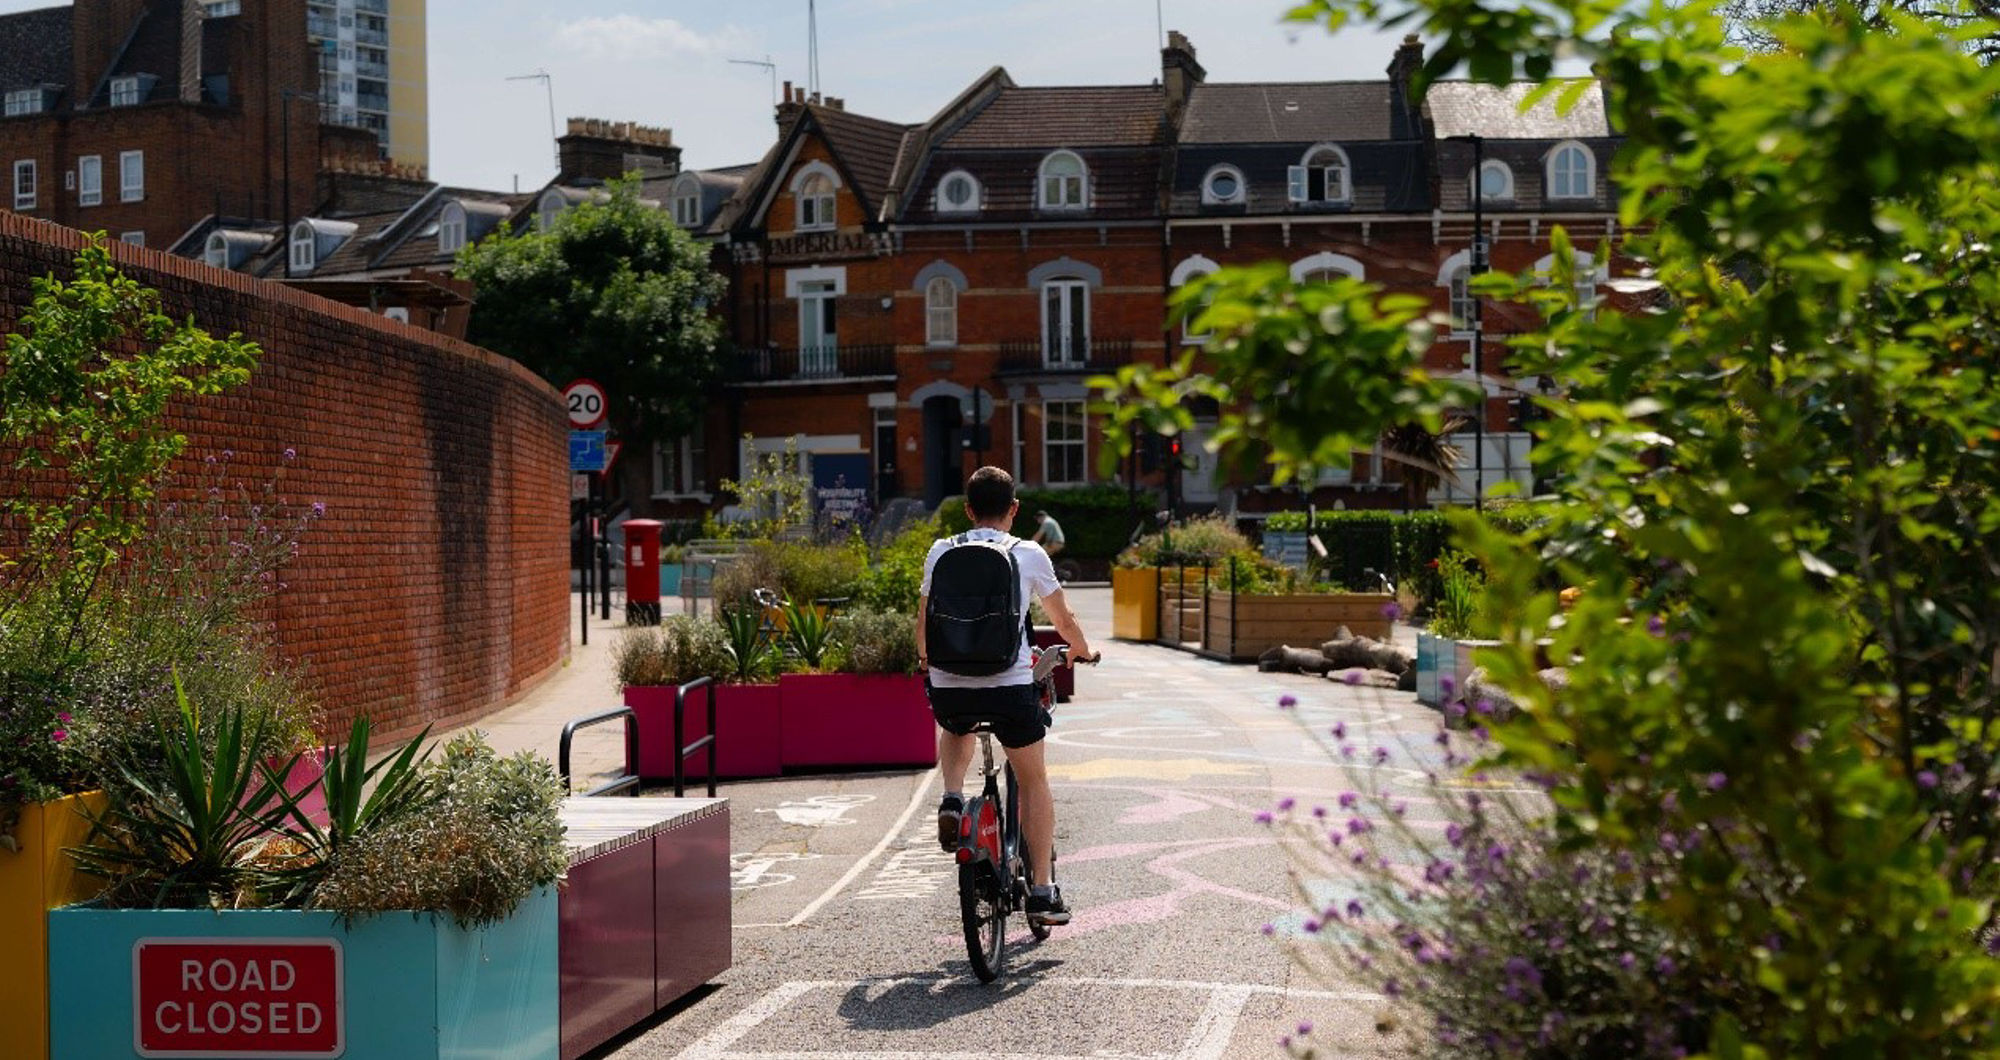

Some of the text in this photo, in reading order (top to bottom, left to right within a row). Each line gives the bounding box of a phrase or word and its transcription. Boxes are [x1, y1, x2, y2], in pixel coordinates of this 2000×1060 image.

[769, 233, 869, 254] IMPERIAL
[569, 394, 600, 413] 20
[182, 959, 296, 991] ROAD
[155, 1001, 322, 1034] CLOSED
